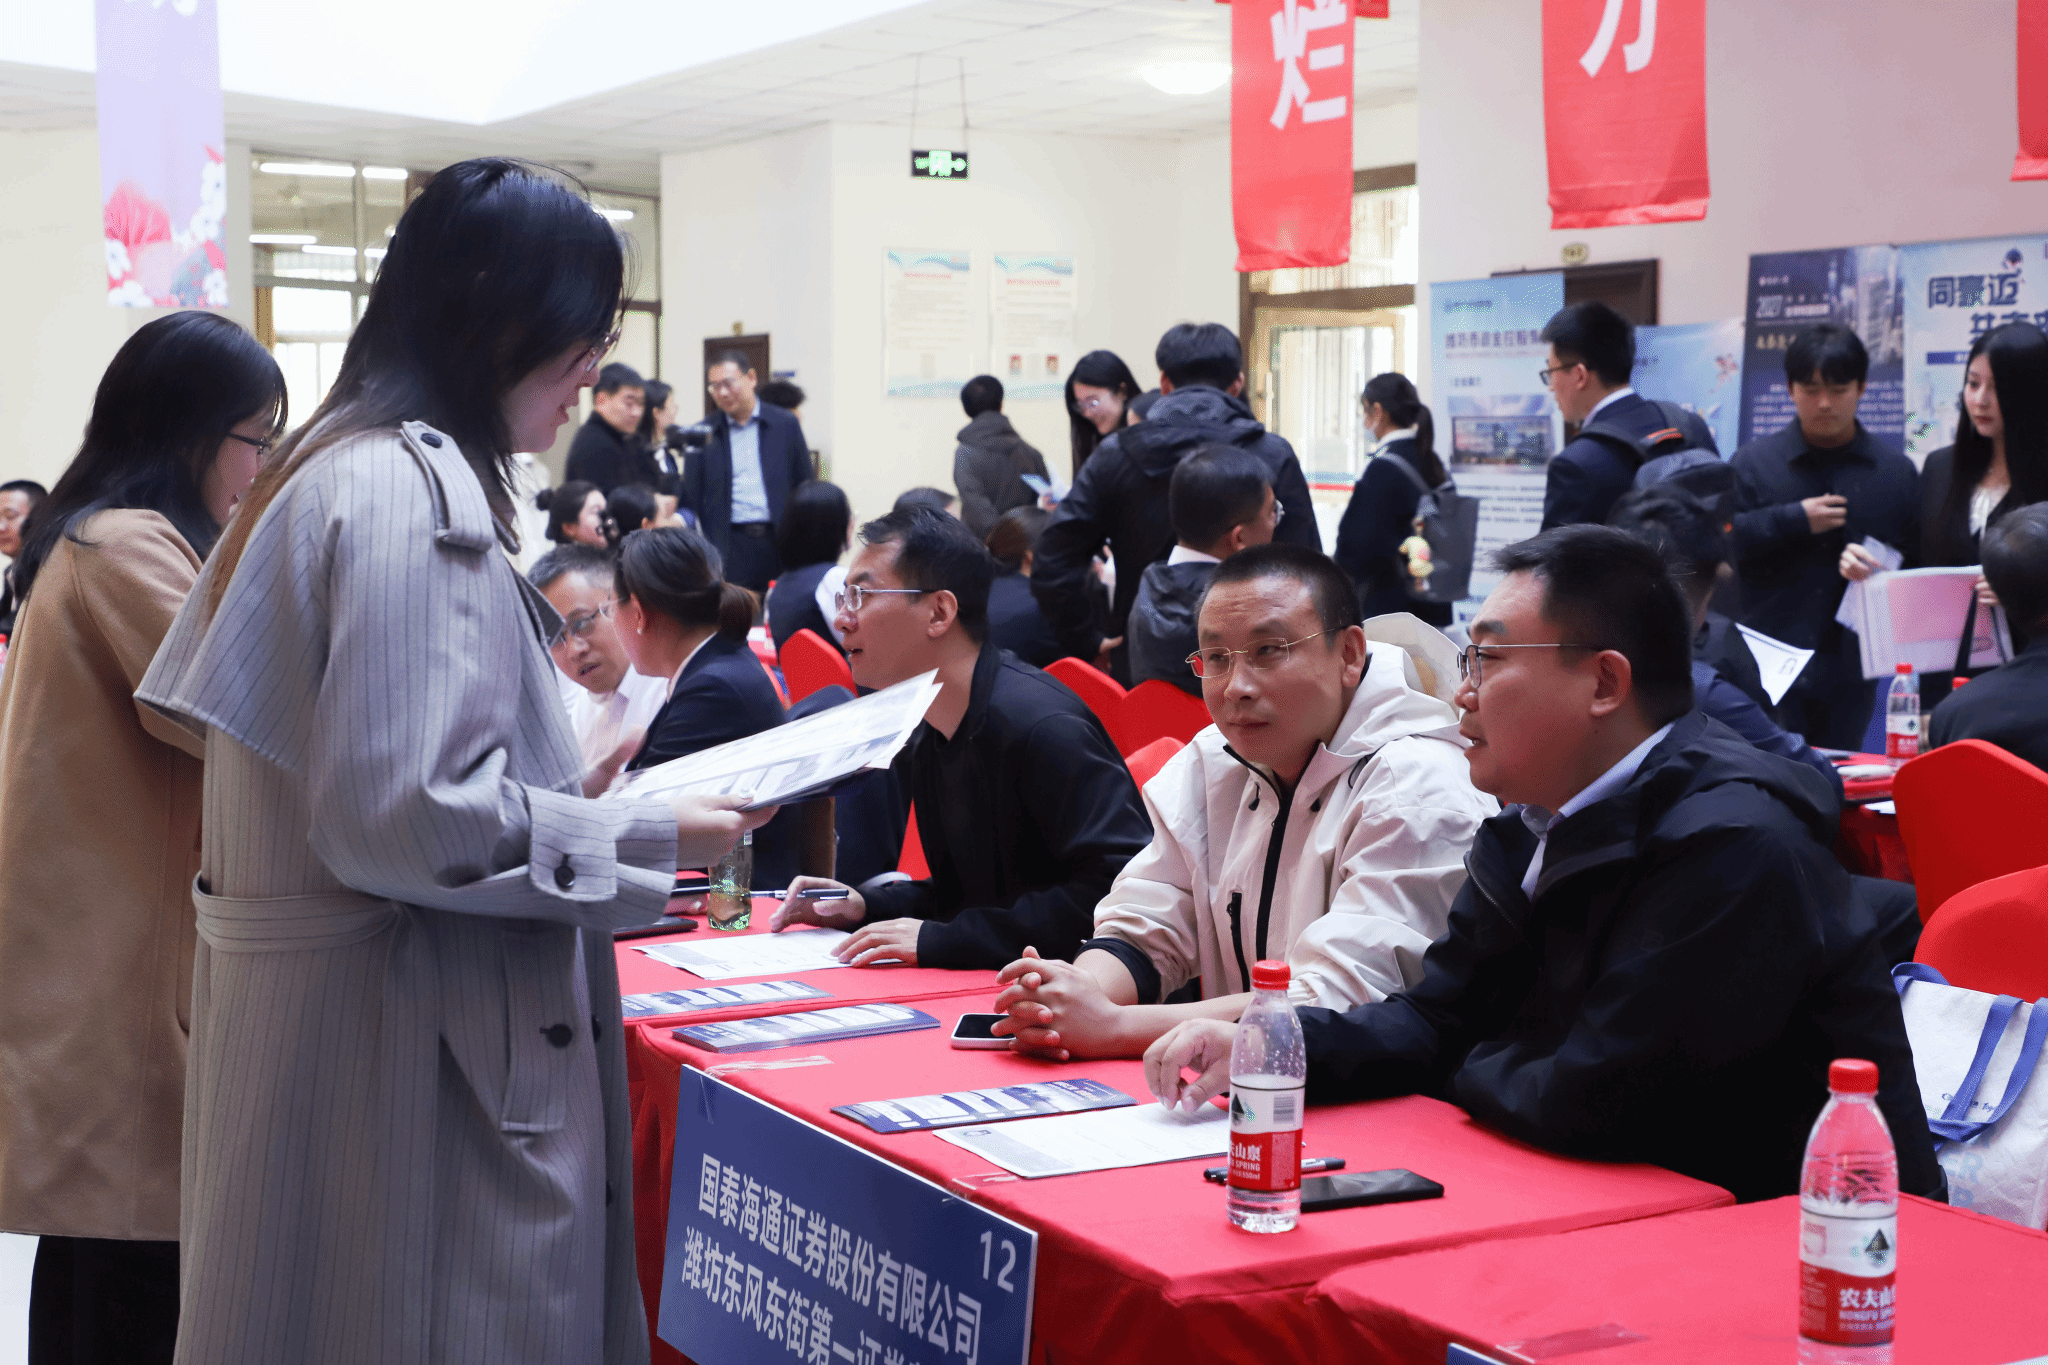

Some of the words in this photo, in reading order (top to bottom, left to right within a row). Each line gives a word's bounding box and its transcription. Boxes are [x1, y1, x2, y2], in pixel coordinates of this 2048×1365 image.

[1270, 0, 1348, 131] 烂
[682, 1225, 920, 1365] 潍坊东风东街第一证
[698, 1153, 982, 1365] 国泰海通证券股份有限公司
[980, 1230, 1016, 1293] 12
